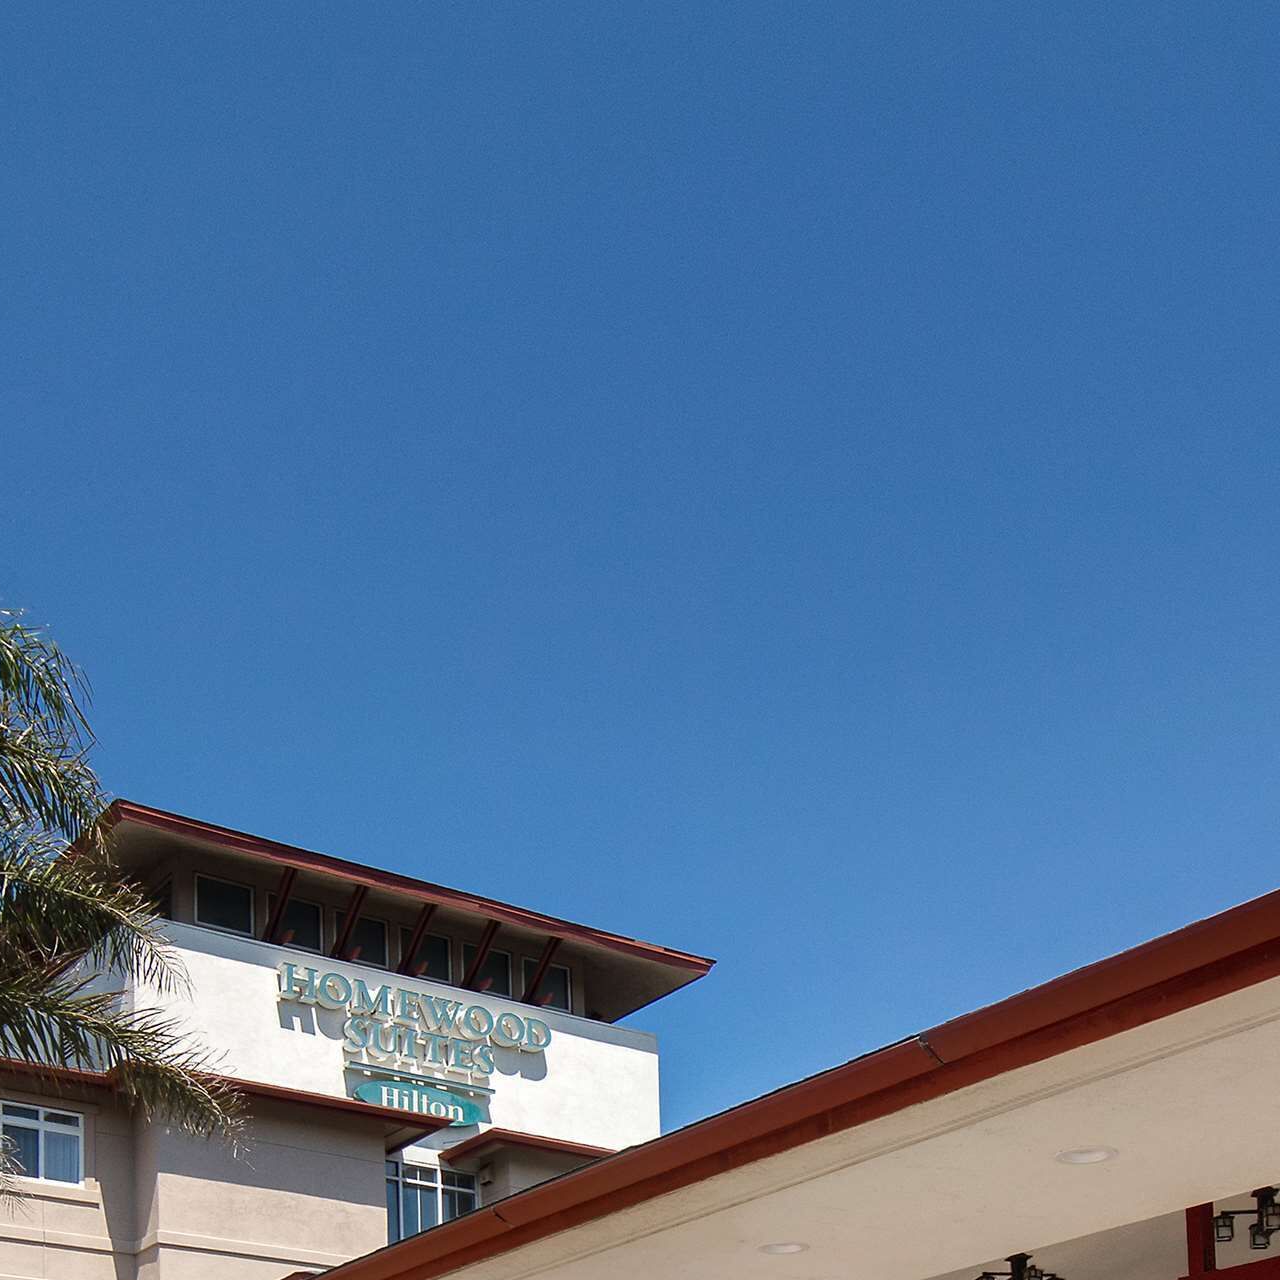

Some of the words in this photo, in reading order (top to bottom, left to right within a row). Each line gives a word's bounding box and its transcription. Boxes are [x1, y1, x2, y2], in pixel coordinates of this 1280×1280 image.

[279, 962, 552, 1051] HOMEWOOD
[344, 1015, 495, 1076] SUITES
[381, 1086, 464, 1122] Hilton
